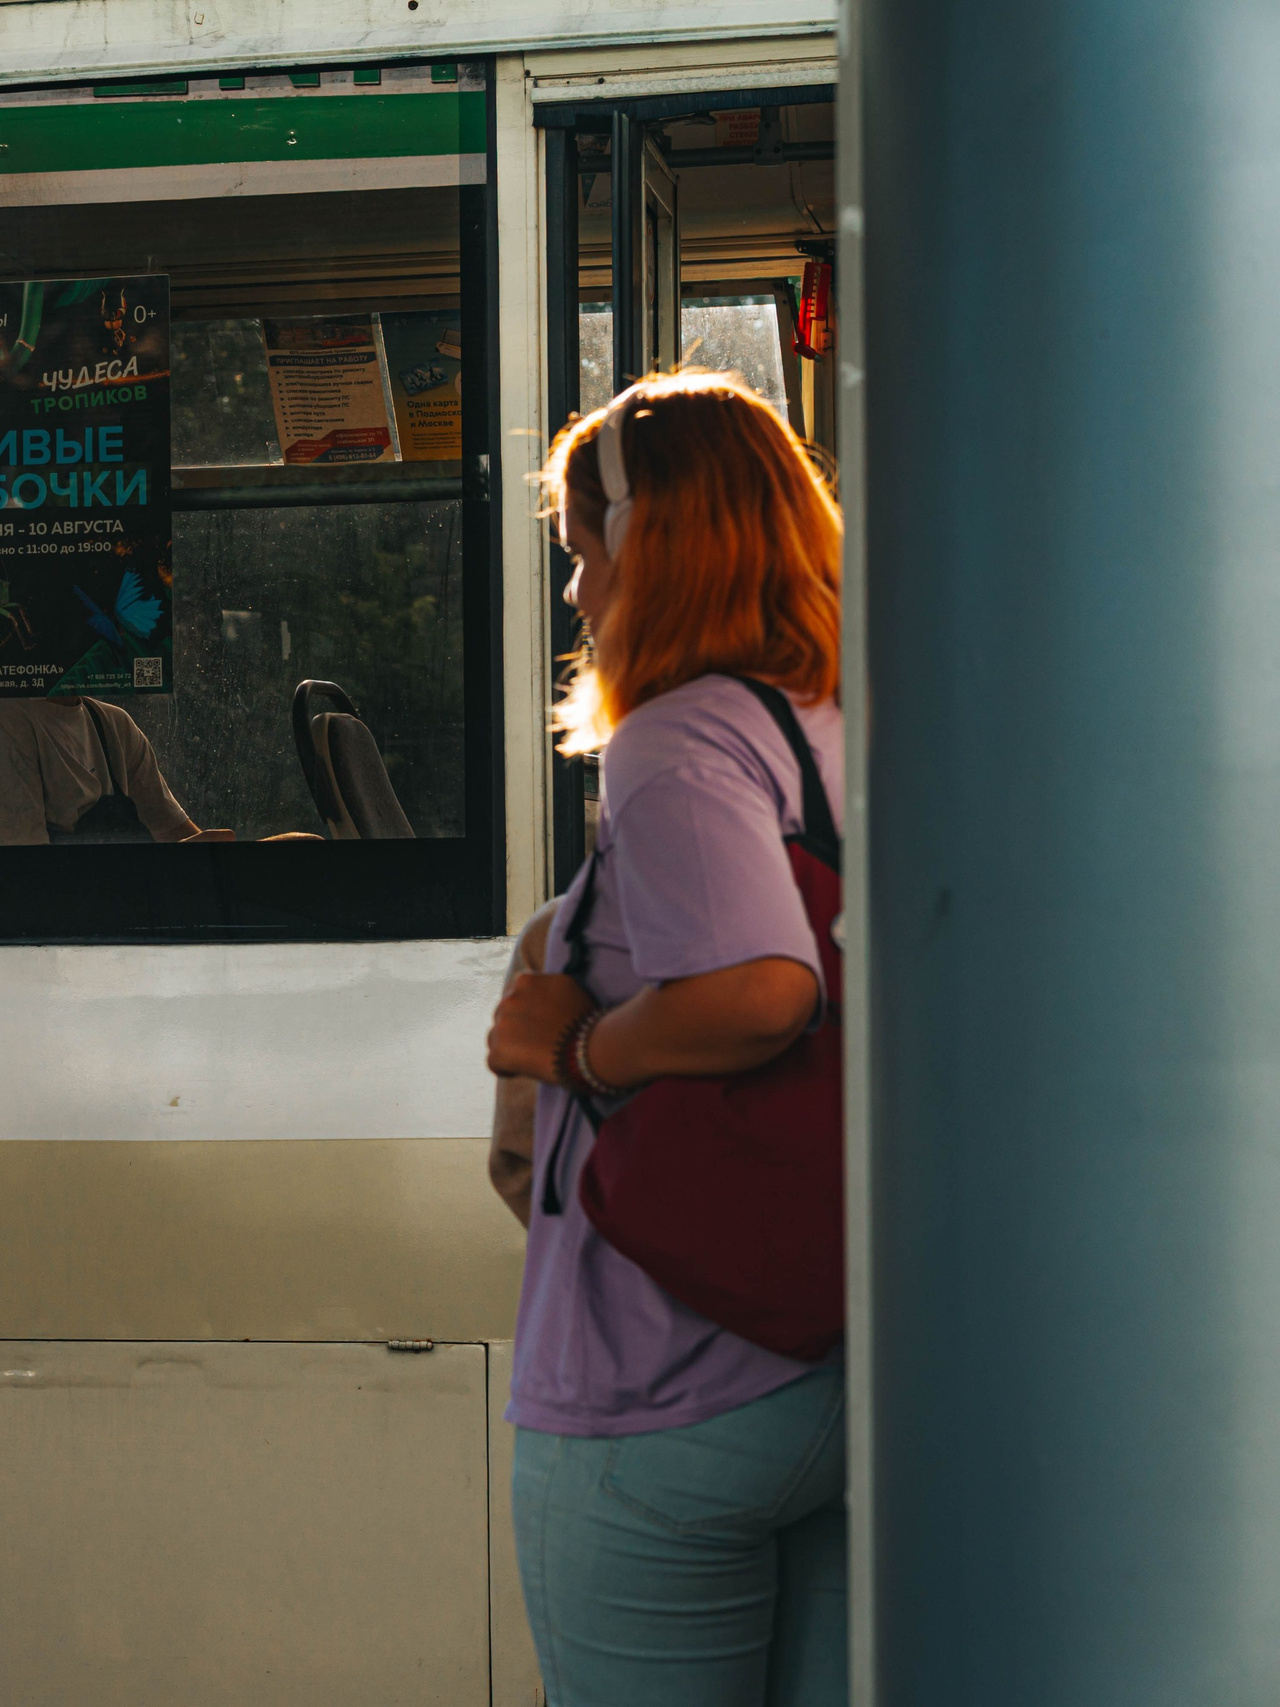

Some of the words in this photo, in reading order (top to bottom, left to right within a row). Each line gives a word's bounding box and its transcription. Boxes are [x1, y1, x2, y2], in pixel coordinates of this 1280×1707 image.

[133, 305, 157, 324] 0+
[276, 356, 324, 365] ПРИГЛАШАЕТ
[339, 355, 368, 363] РАБОТУ
[42, 355, 139, 392] ЧУДЕСА
[30, 384, 148, 415] ТРОПИКОВ
[407, 400, 431, 409] Одна
[433, 400, 458, 408] карта
[29, 522, 48, 536] 10
[51, 519, 124, 535] АВГУСТА
[17, 546, 24, 555] с
[26, 543, 58, 555] 11:00
[60, 544, 75, 555] до
[77, 541, 112, 553] 19:00
[20, 679, 30, 688] д.
